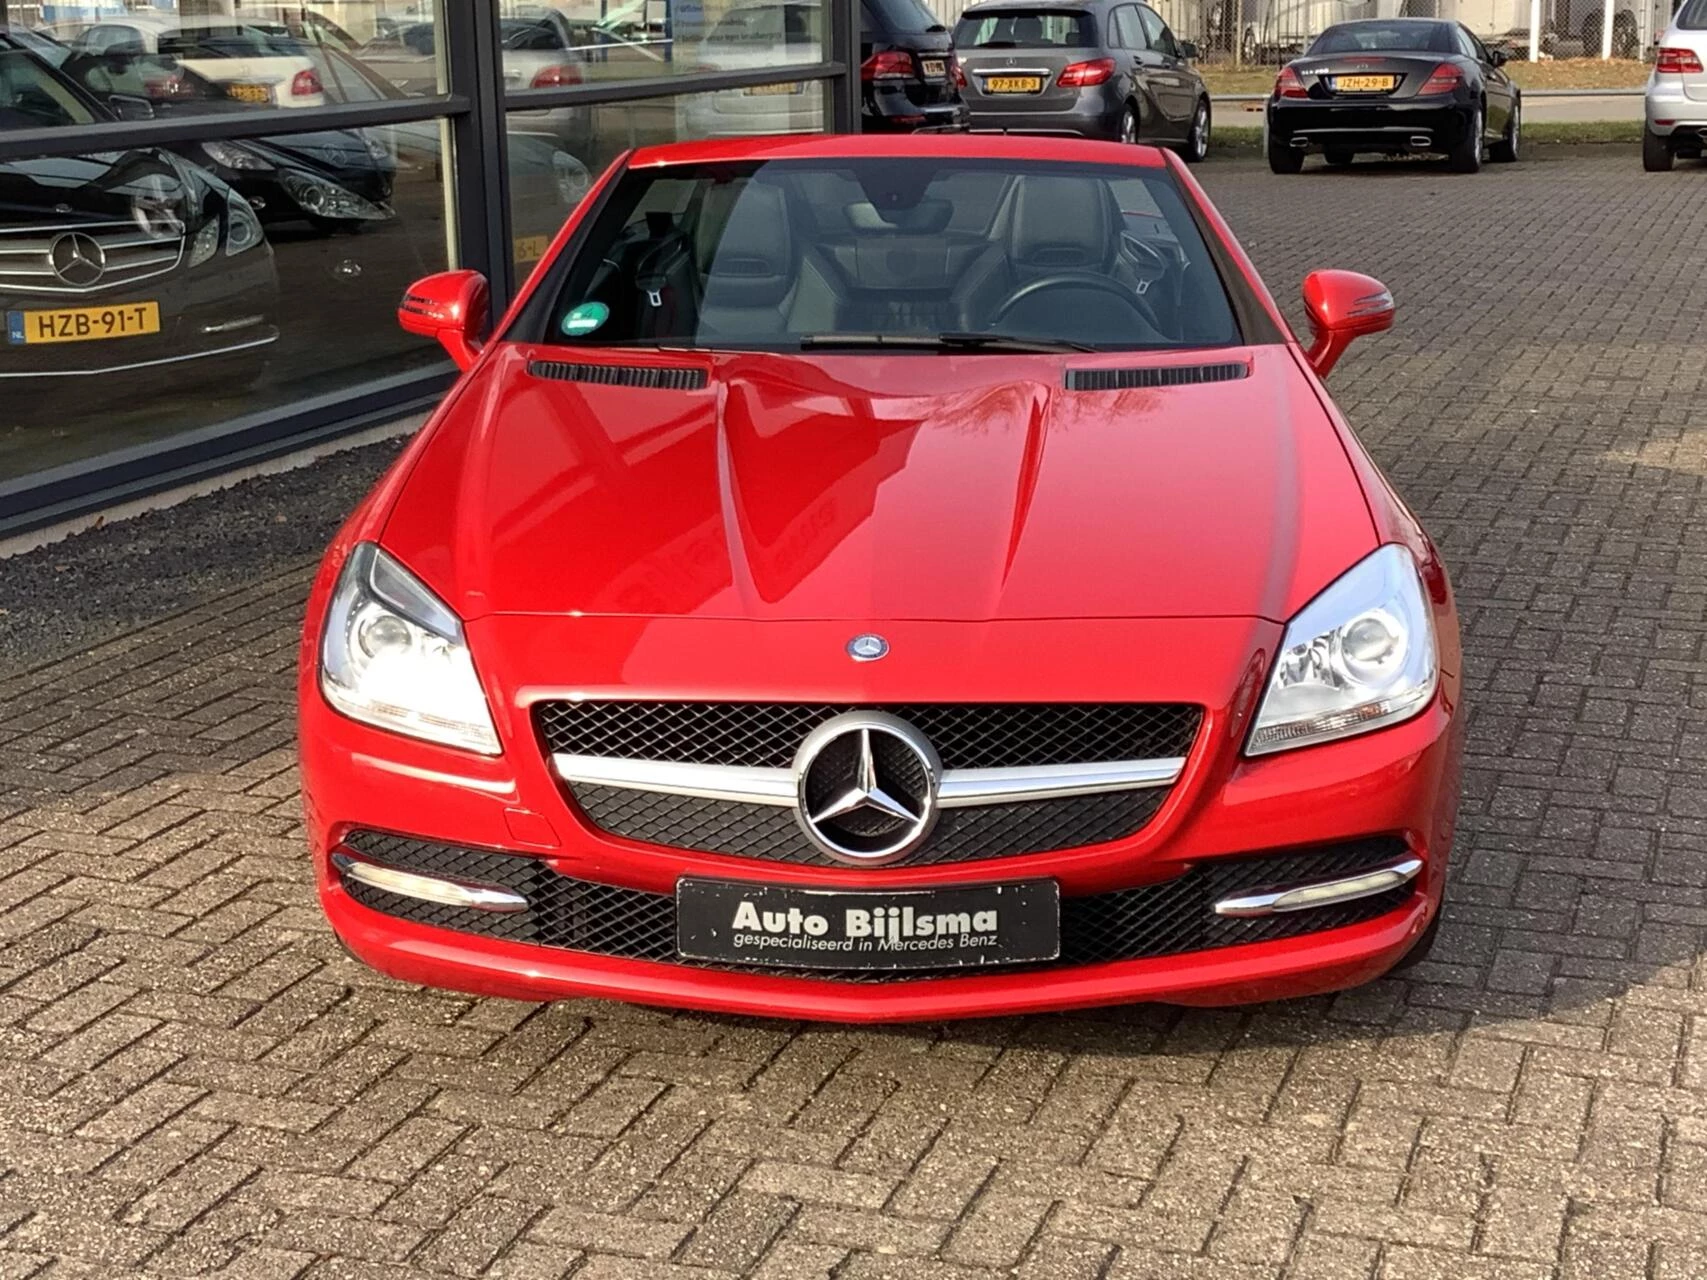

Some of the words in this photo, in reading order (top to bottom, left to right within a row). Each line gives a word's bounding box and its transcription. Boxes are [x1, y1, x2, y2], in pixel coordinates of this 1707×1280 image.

[1341, 78, 1389, 88] JZH-29-B
[38, 308, 147, 338] HZB-91-T
[12, 331, 24, 340] NL
[732, 901, 828, 936] Auto
[846, 907, 997, 943] Bijlsma
[733, 934, 853, 951] gespecialiseerd
[859, 938, 872, 951] in
[876, 936, 954, 951] Mercedes
[960, 934, 997, 948] Benz
